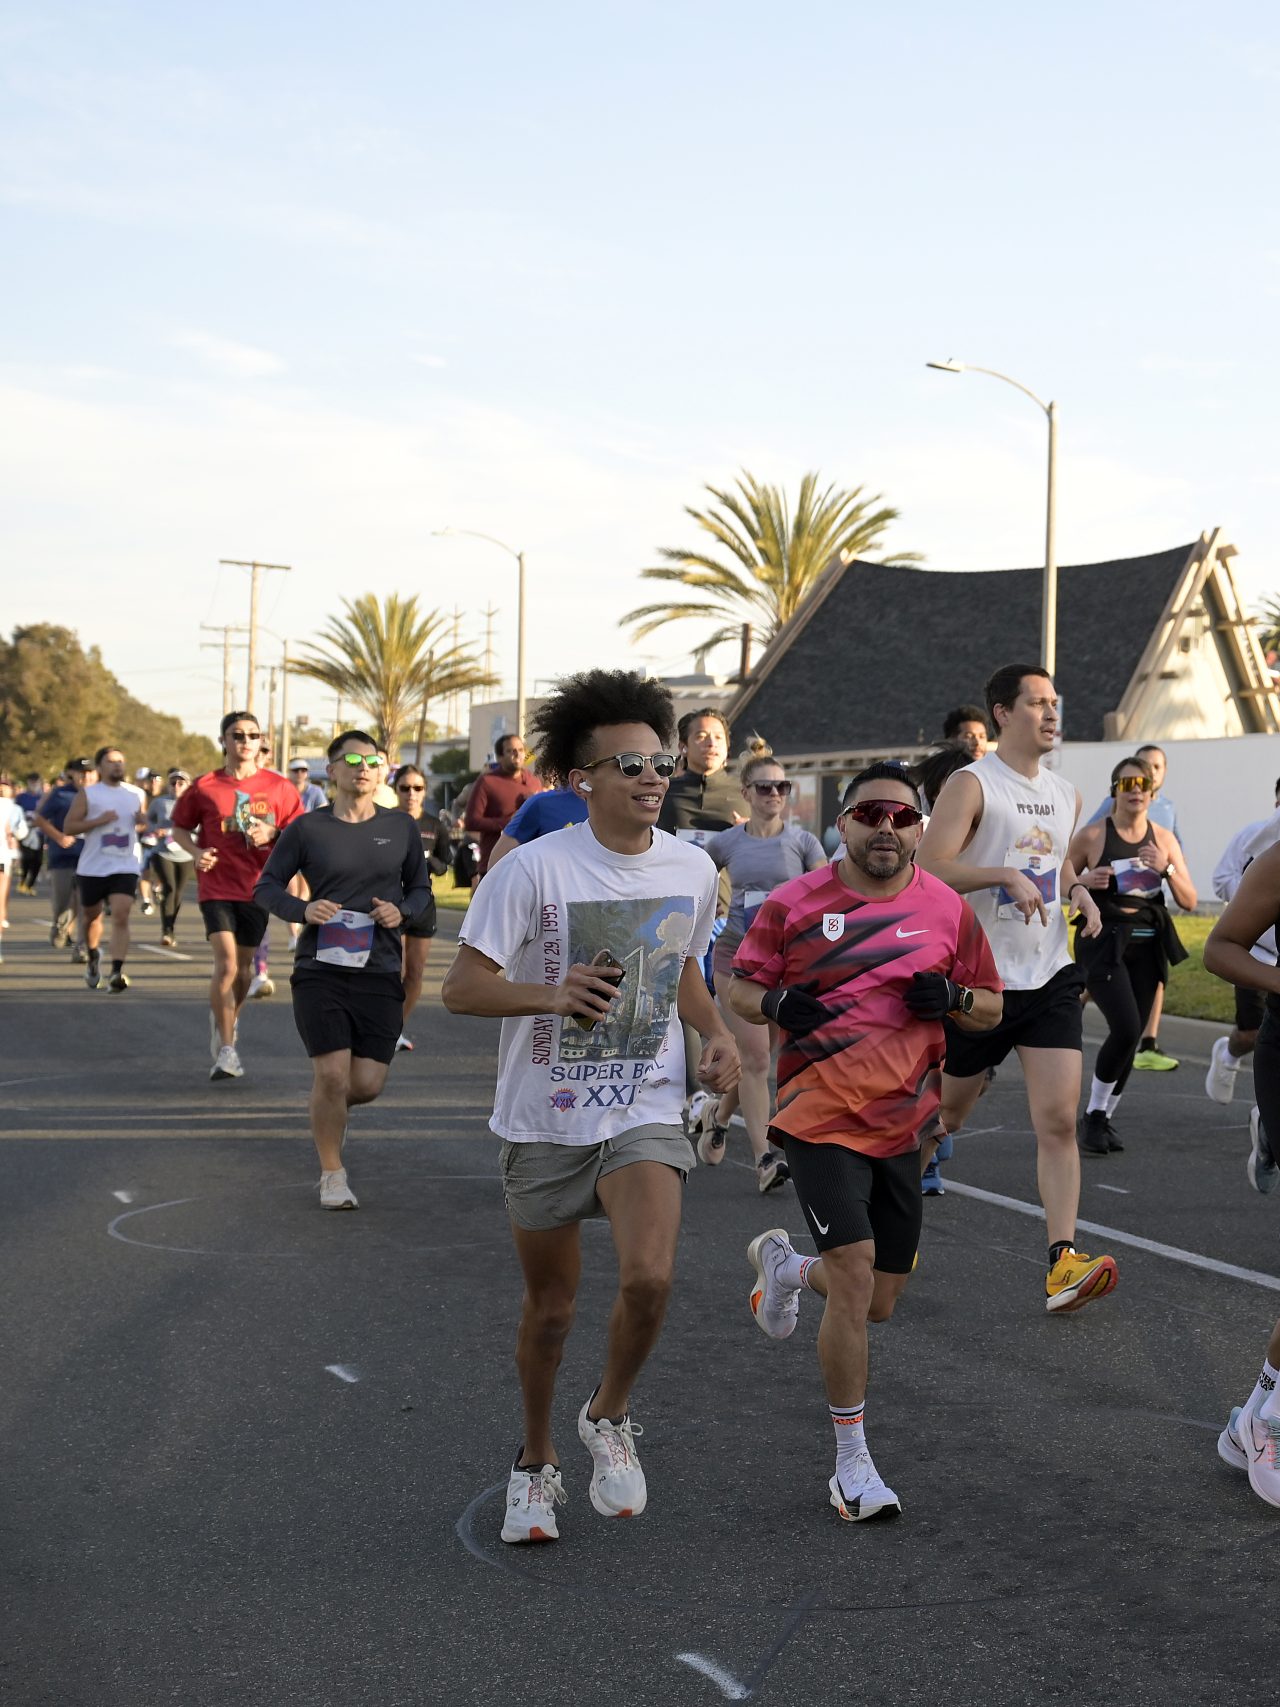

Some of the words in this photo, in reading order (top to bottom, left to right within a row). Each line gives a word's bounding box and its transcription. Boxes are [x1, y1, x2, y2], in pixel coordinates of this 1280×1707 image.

[532, 1017, 553, 1066] SUNDAY
[543, 904, 558, 933] 1995
[550, 1063, 624, 1082] SUPER
[582, 1081, 646, 1107] XXI
